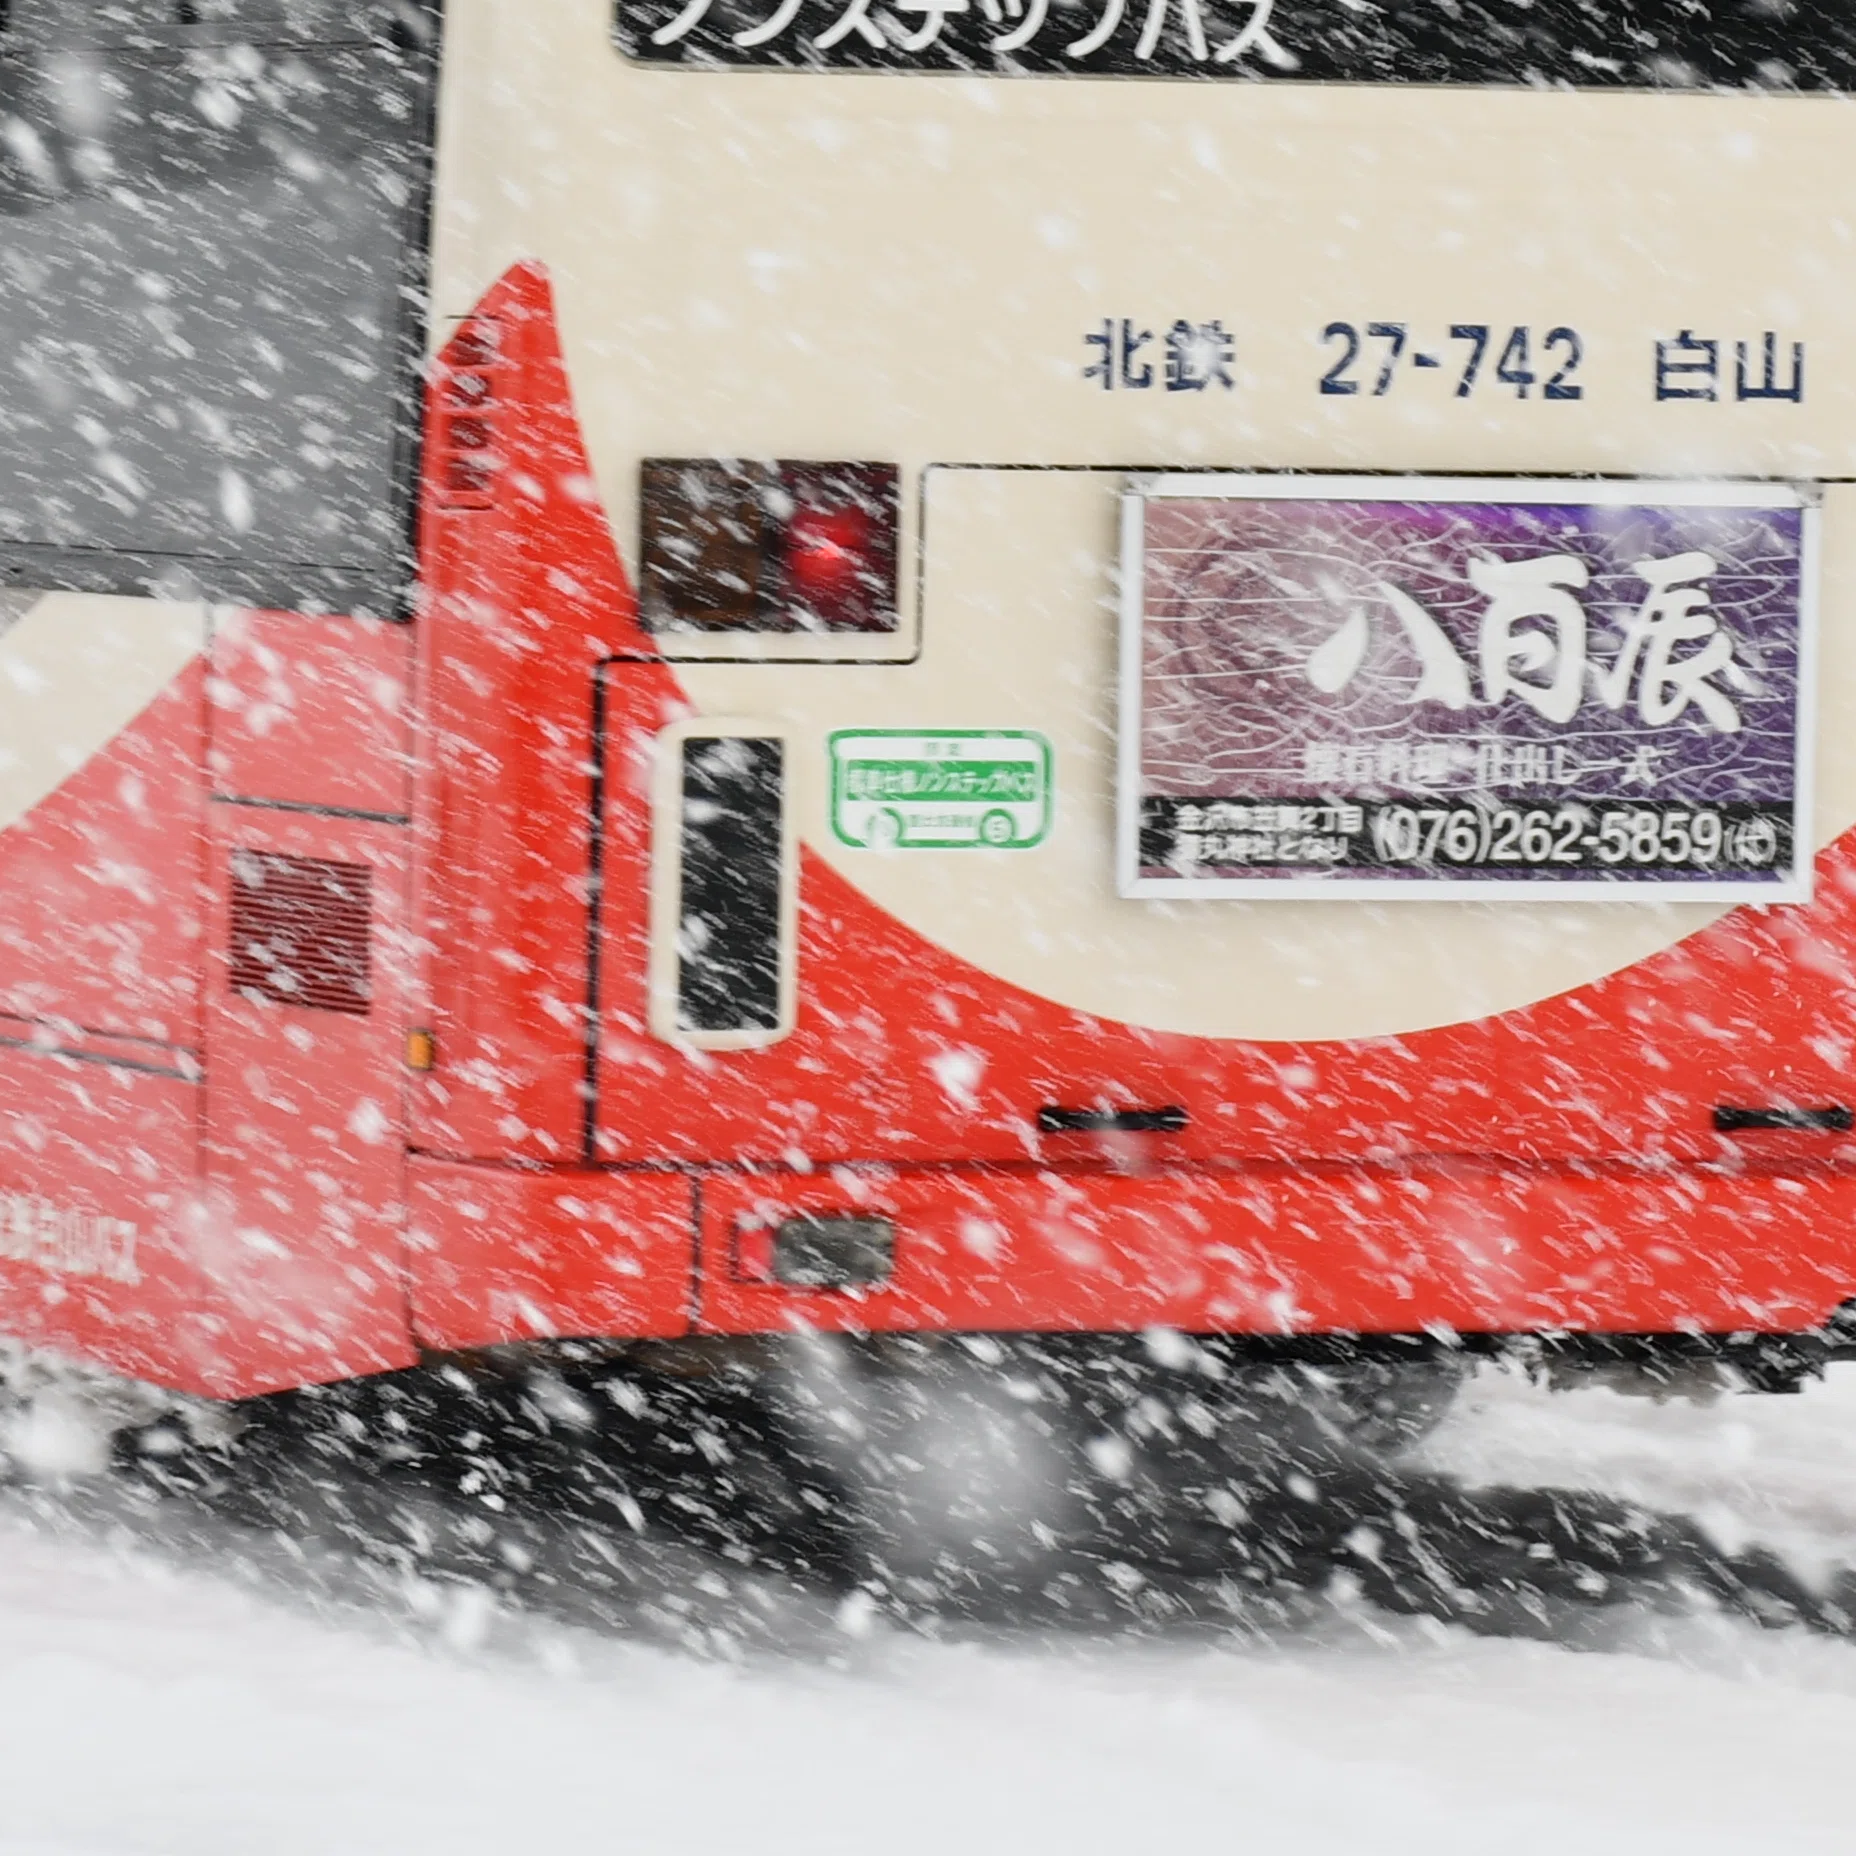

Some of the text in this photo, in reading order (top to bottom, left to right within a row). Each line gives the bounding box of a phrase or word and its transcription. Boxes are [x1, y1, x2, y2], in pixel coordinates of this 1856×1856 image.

[1082, 318, 1804, 404] 北鉄 27-742 白山
[1306, 551, 1742, 734] 八百辰
